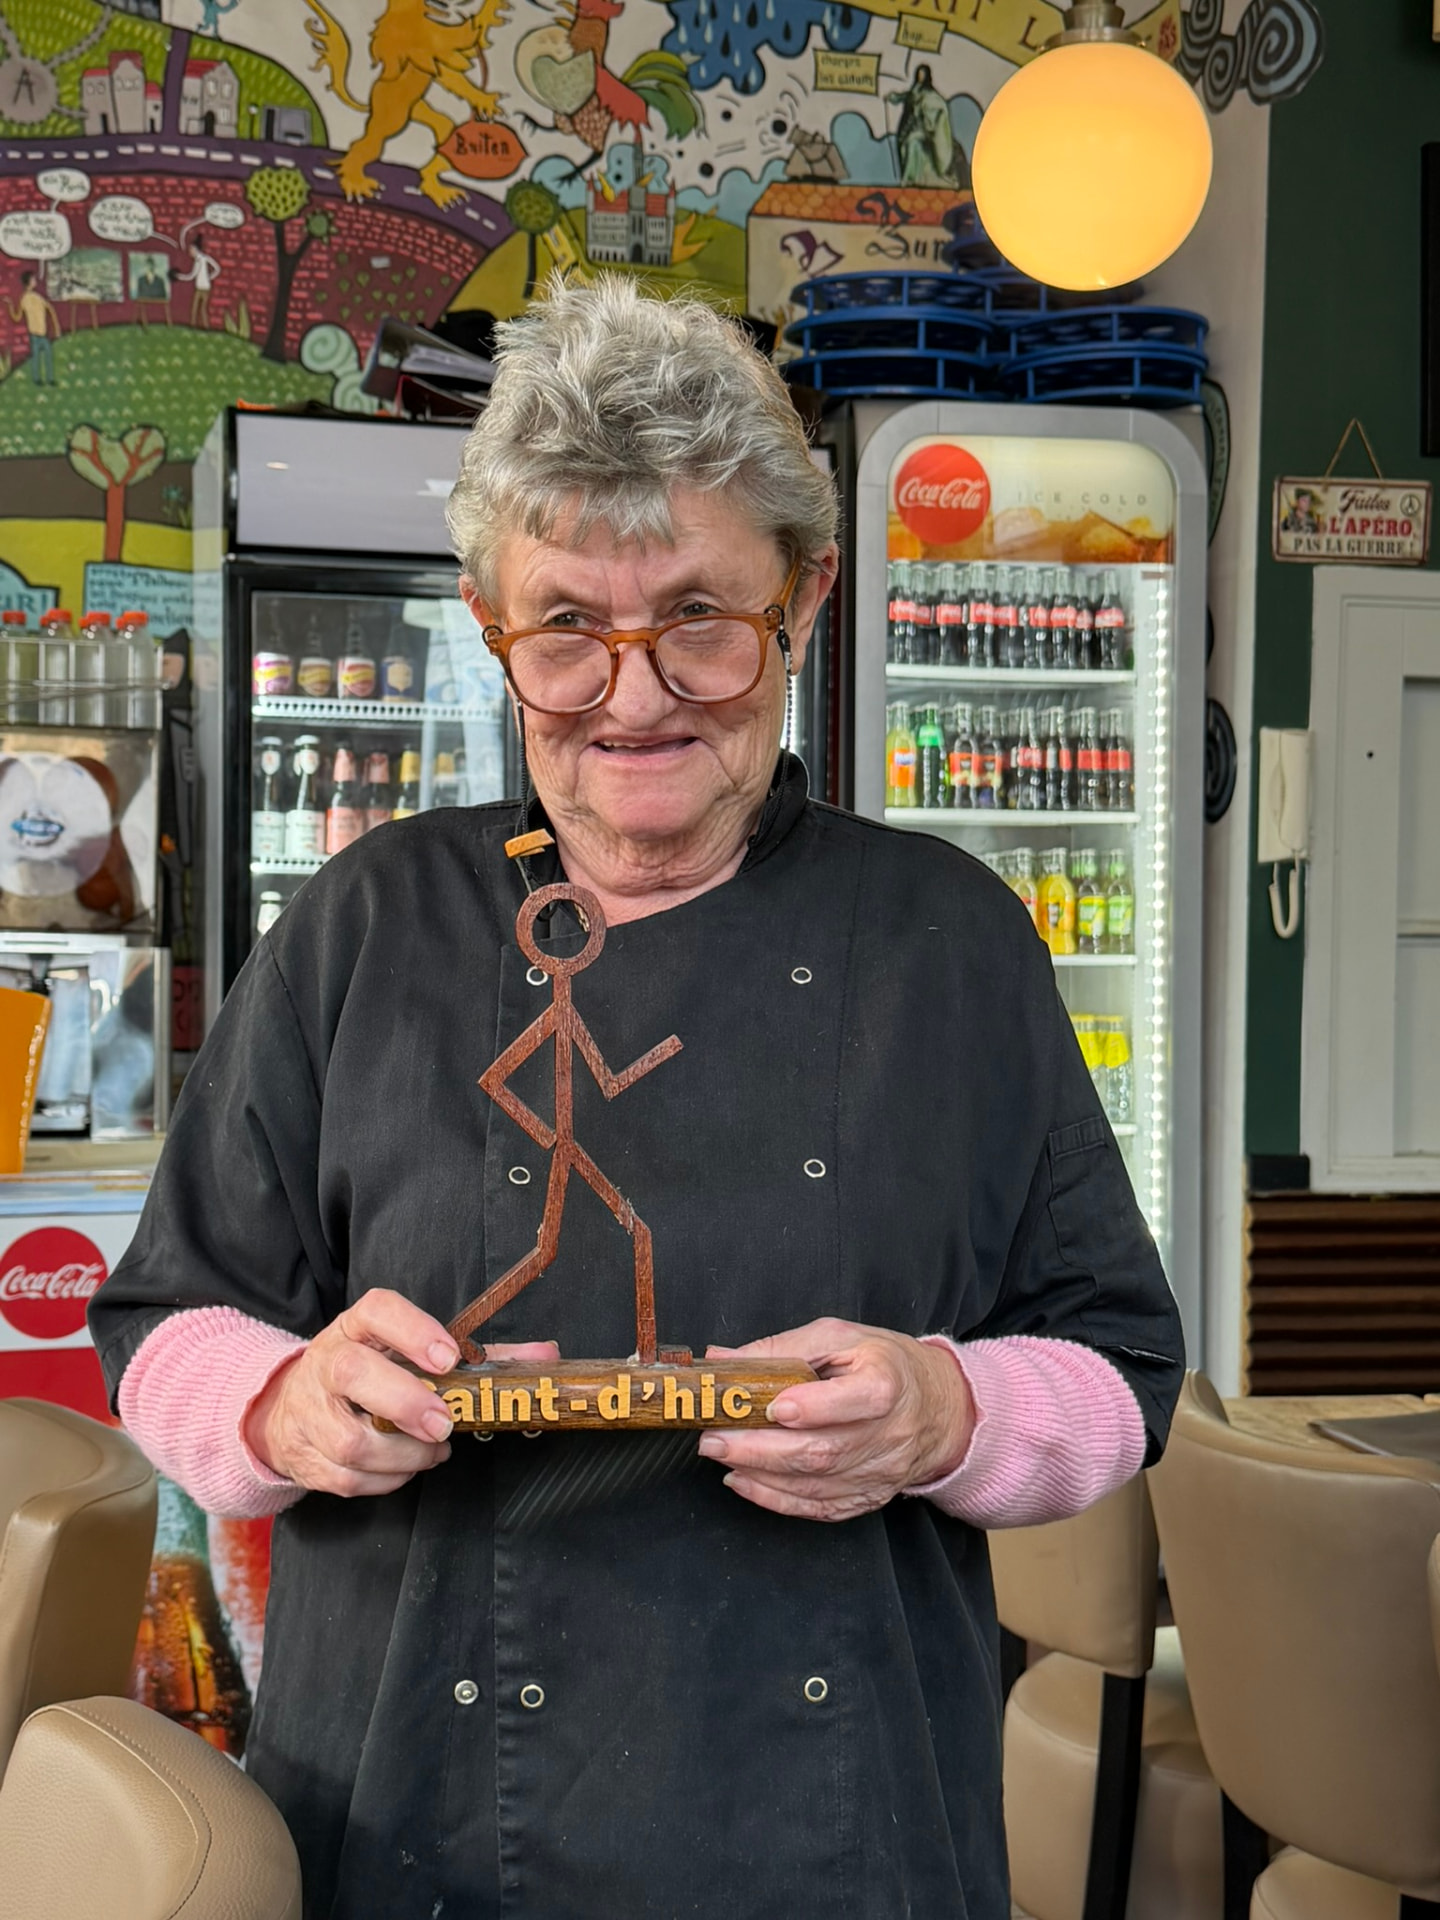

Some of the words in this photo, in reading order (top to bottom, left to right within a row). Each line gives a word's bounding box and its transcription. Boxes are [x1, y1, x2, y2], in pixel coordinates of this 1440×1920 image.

[899, 477, 987, 509] Coca-Cola
[1017, 490, 1062, 504] ICE
[1080, 492, 1147, 507] COLD
[1293, 537, 1321, 550] PAS
[1325, 538, 1343, 552] LA
[1345, 541, 1405, 555] GUERRE
[0, 1263, 104, 1301] Coca-Cola
[421, 1373, 753, 1422] aint-d'hic
